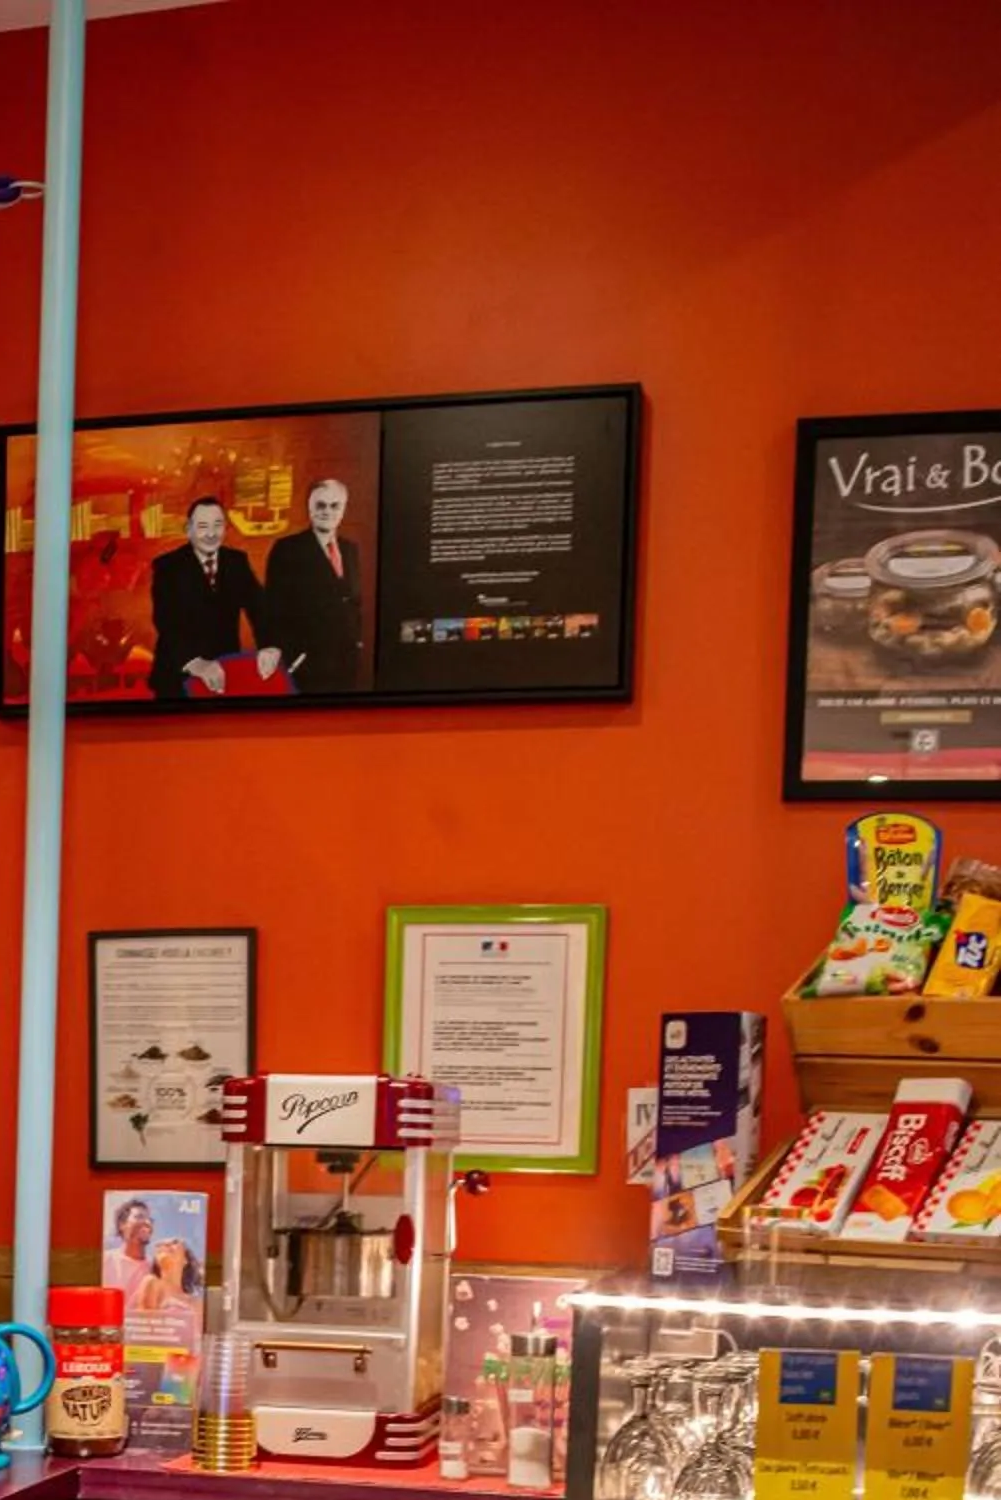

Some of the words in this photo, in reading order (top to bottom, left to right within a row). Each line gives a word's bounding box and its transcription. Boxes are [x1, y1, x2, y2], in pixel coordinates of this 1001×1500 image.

[828, 452, 918, 497] Vrai
[925, 463, 951, 489] &
[279, 1091, 359, 1121] Popcorn
[877, 1113, 928, 1182] Biscoff
